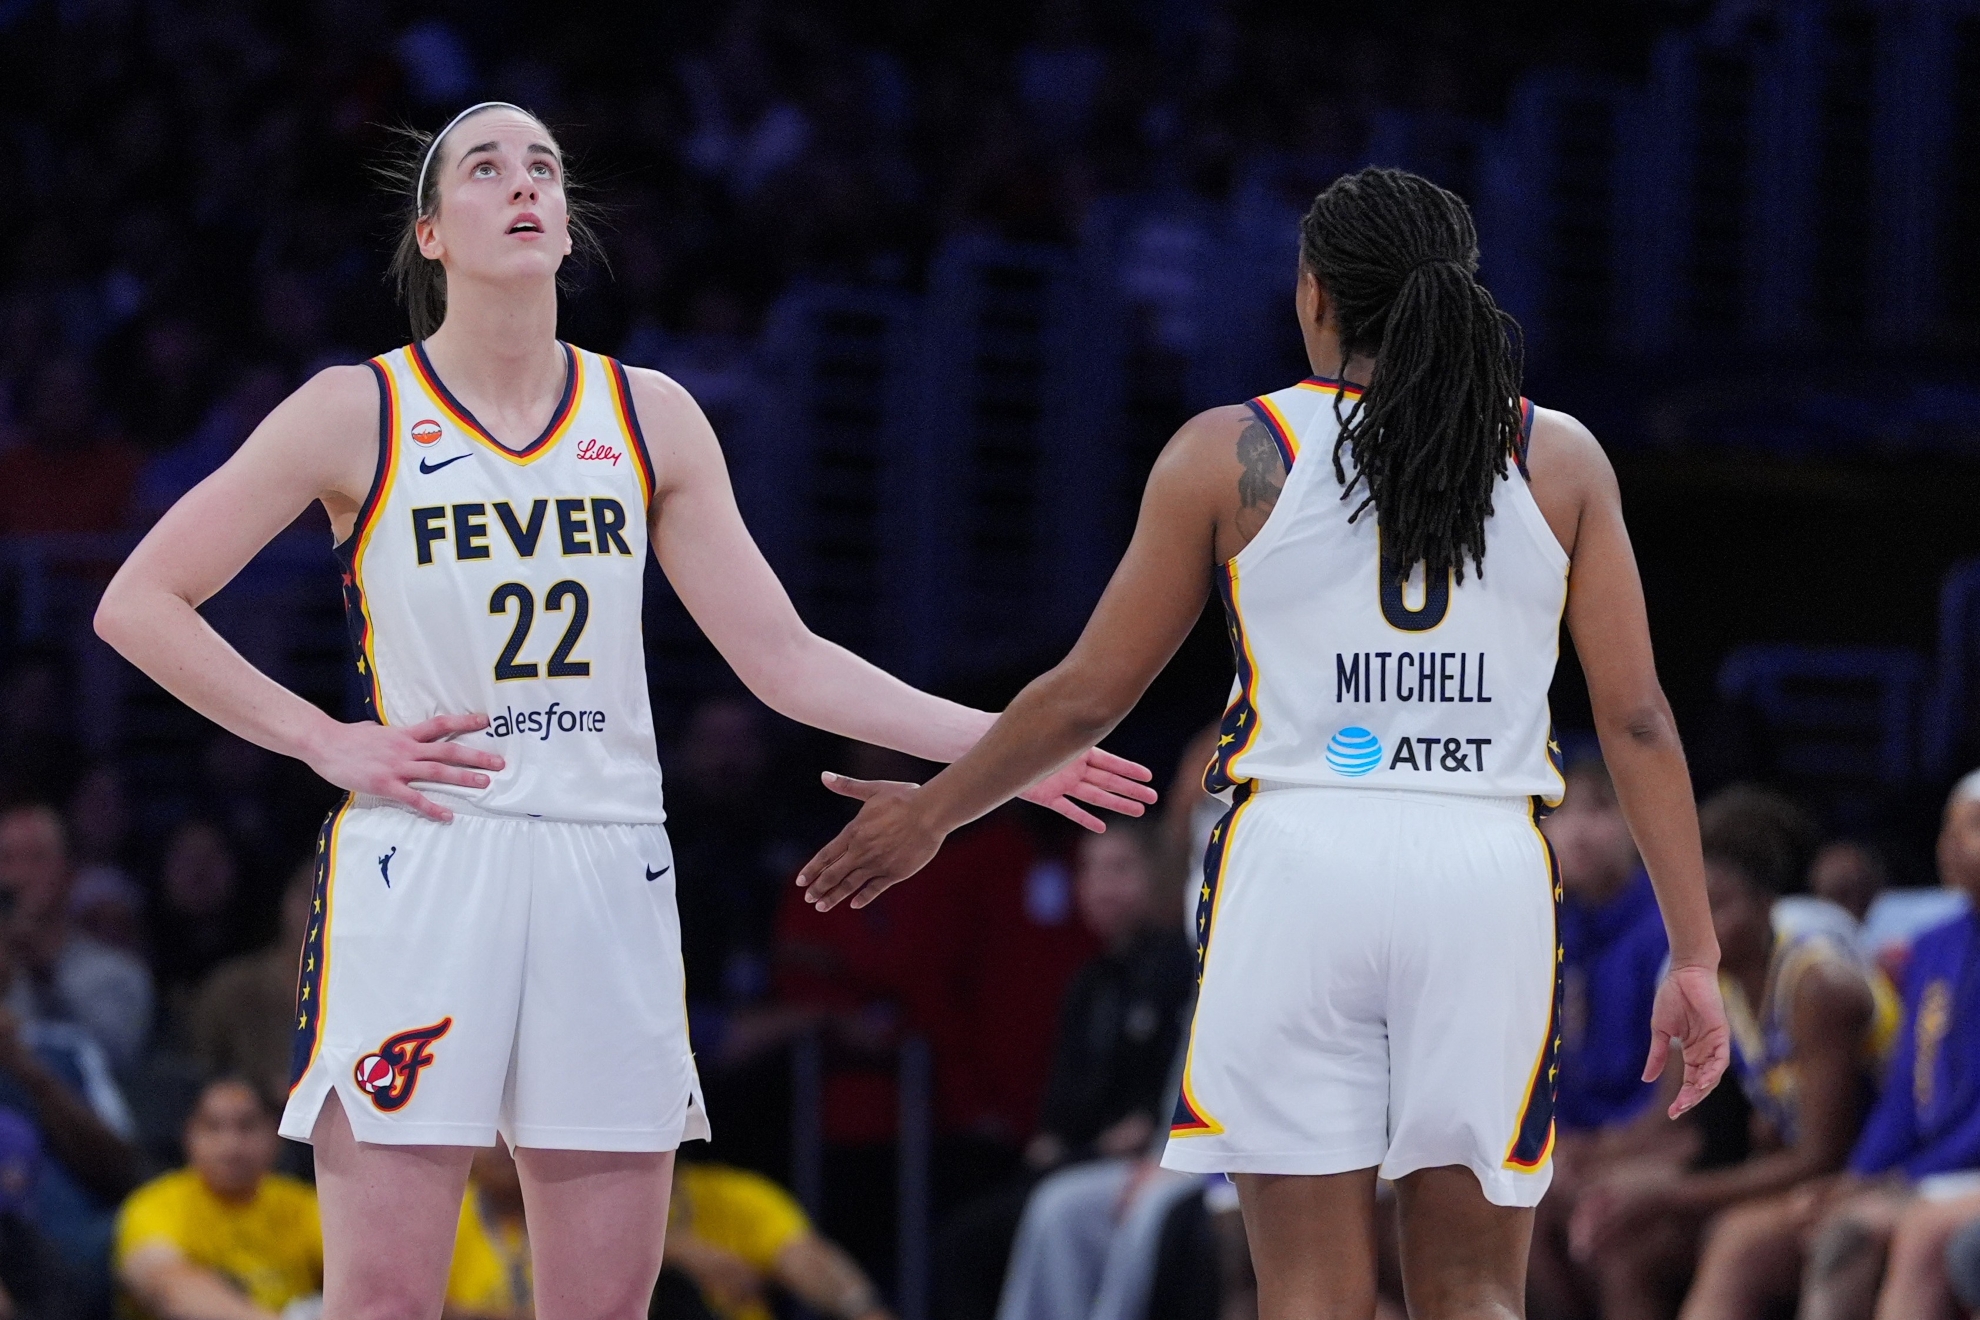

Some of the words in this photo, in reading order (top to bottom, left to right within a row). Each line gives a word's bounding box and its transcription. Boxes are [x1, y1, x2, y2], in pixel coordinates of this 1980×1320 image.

[576, 438, 622, 467] Lilly
[411, 497, 634, 568] FEVER
[488, 578, 592, 684] 22
[1336, 651, 1492, 703] MITCHELL
[1389, 736, 1492, 772] AT&T
